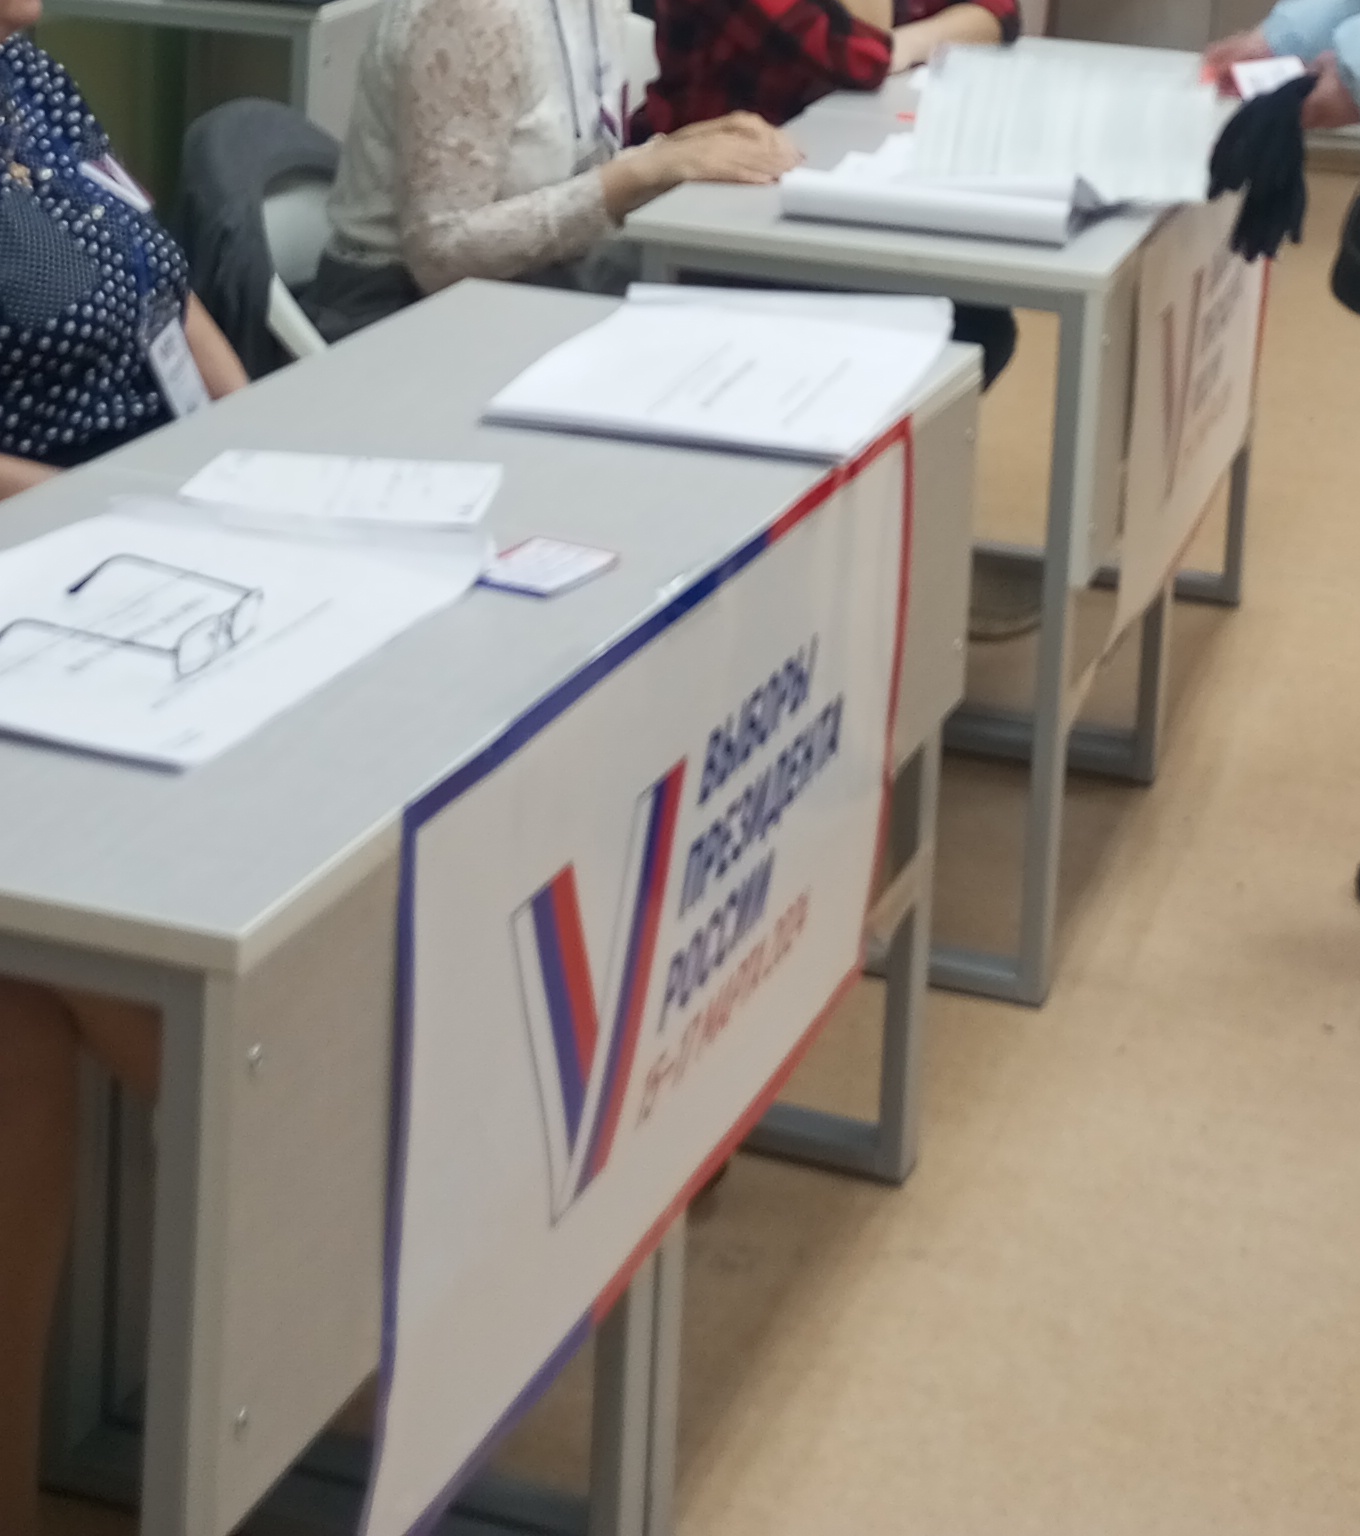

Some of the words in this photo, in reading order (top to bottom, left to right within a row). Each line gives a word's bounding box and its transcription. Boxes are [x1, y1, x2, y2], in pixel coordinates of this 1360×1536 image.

[678, 691, 845, 920] ПРЕЗИДЕНТА
[697, 632, 819, 806] ВЫБОРЫ
[656, 847, 775, 1036] РОССИИ
